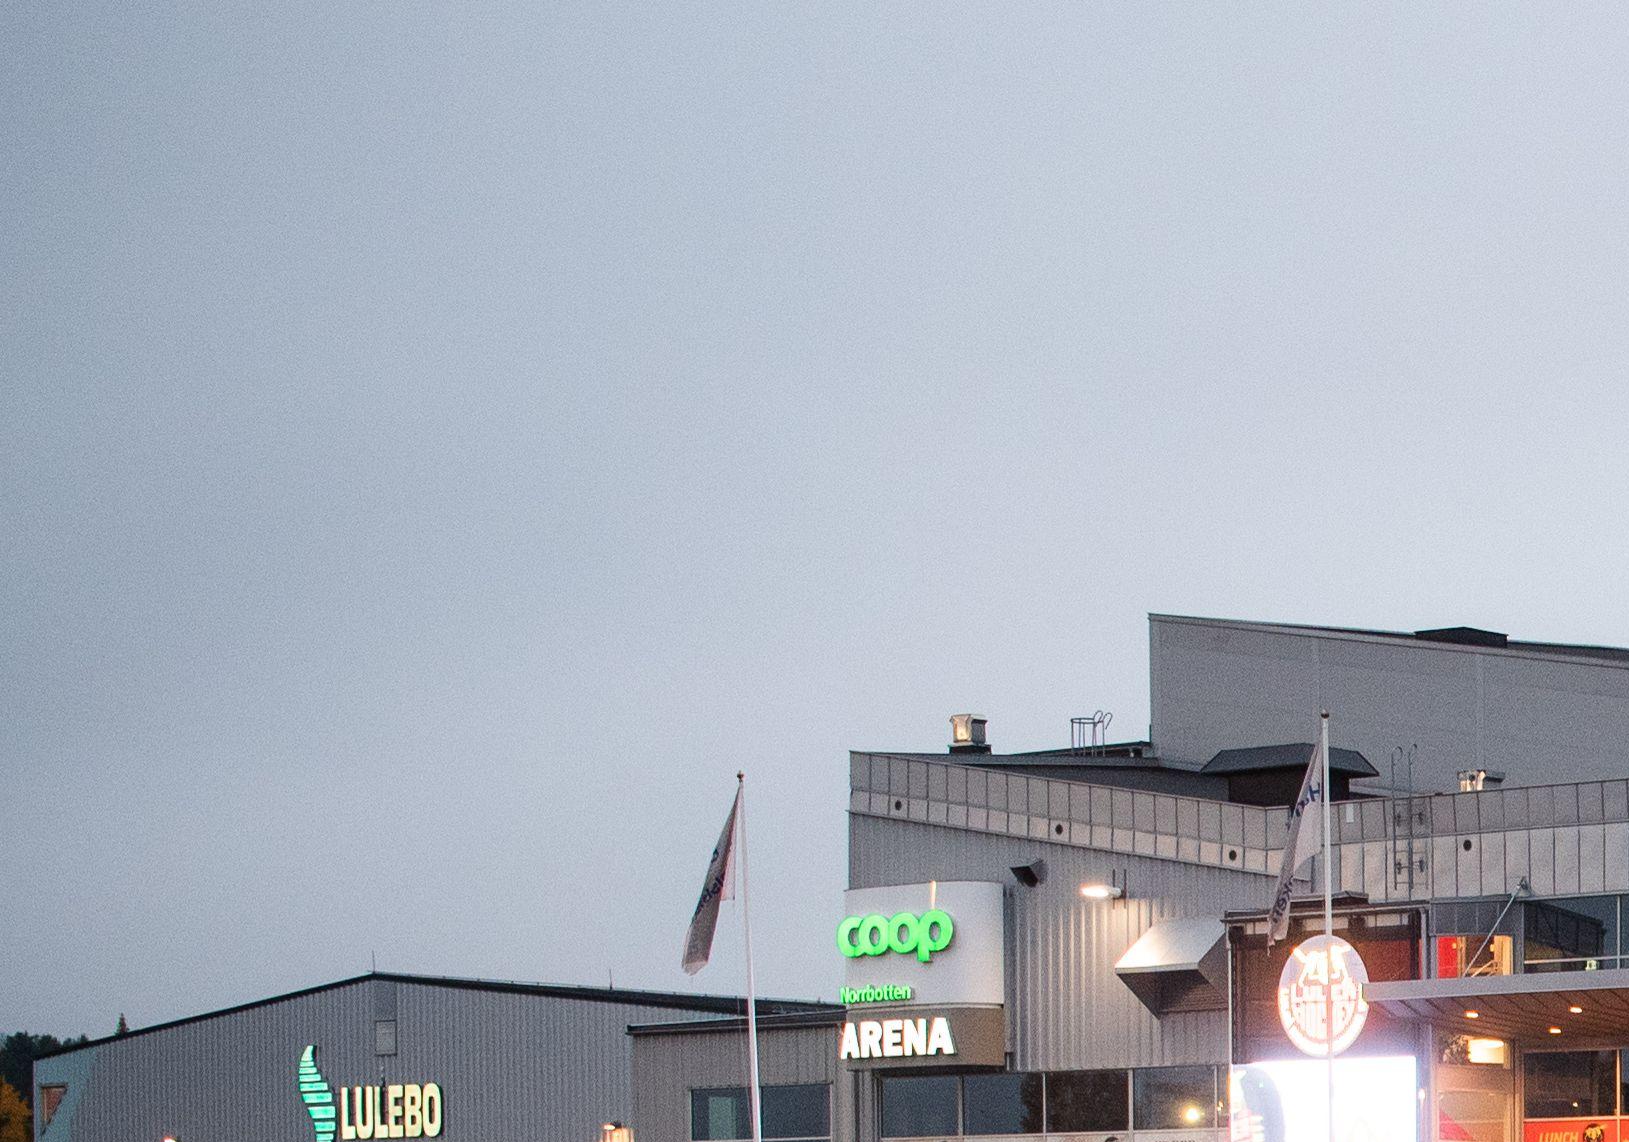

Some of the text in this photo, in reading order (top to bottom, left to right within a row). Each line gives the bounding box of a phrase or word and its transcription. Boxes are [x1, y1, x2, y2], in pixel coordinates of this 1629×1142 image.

[837, 909, 954, 962] coop
[840, 984, 912, 1004] Norrbotten
[840, 1017, 955, 1060] ARENA
[340, 1083, 442, 1140] LULEBO
